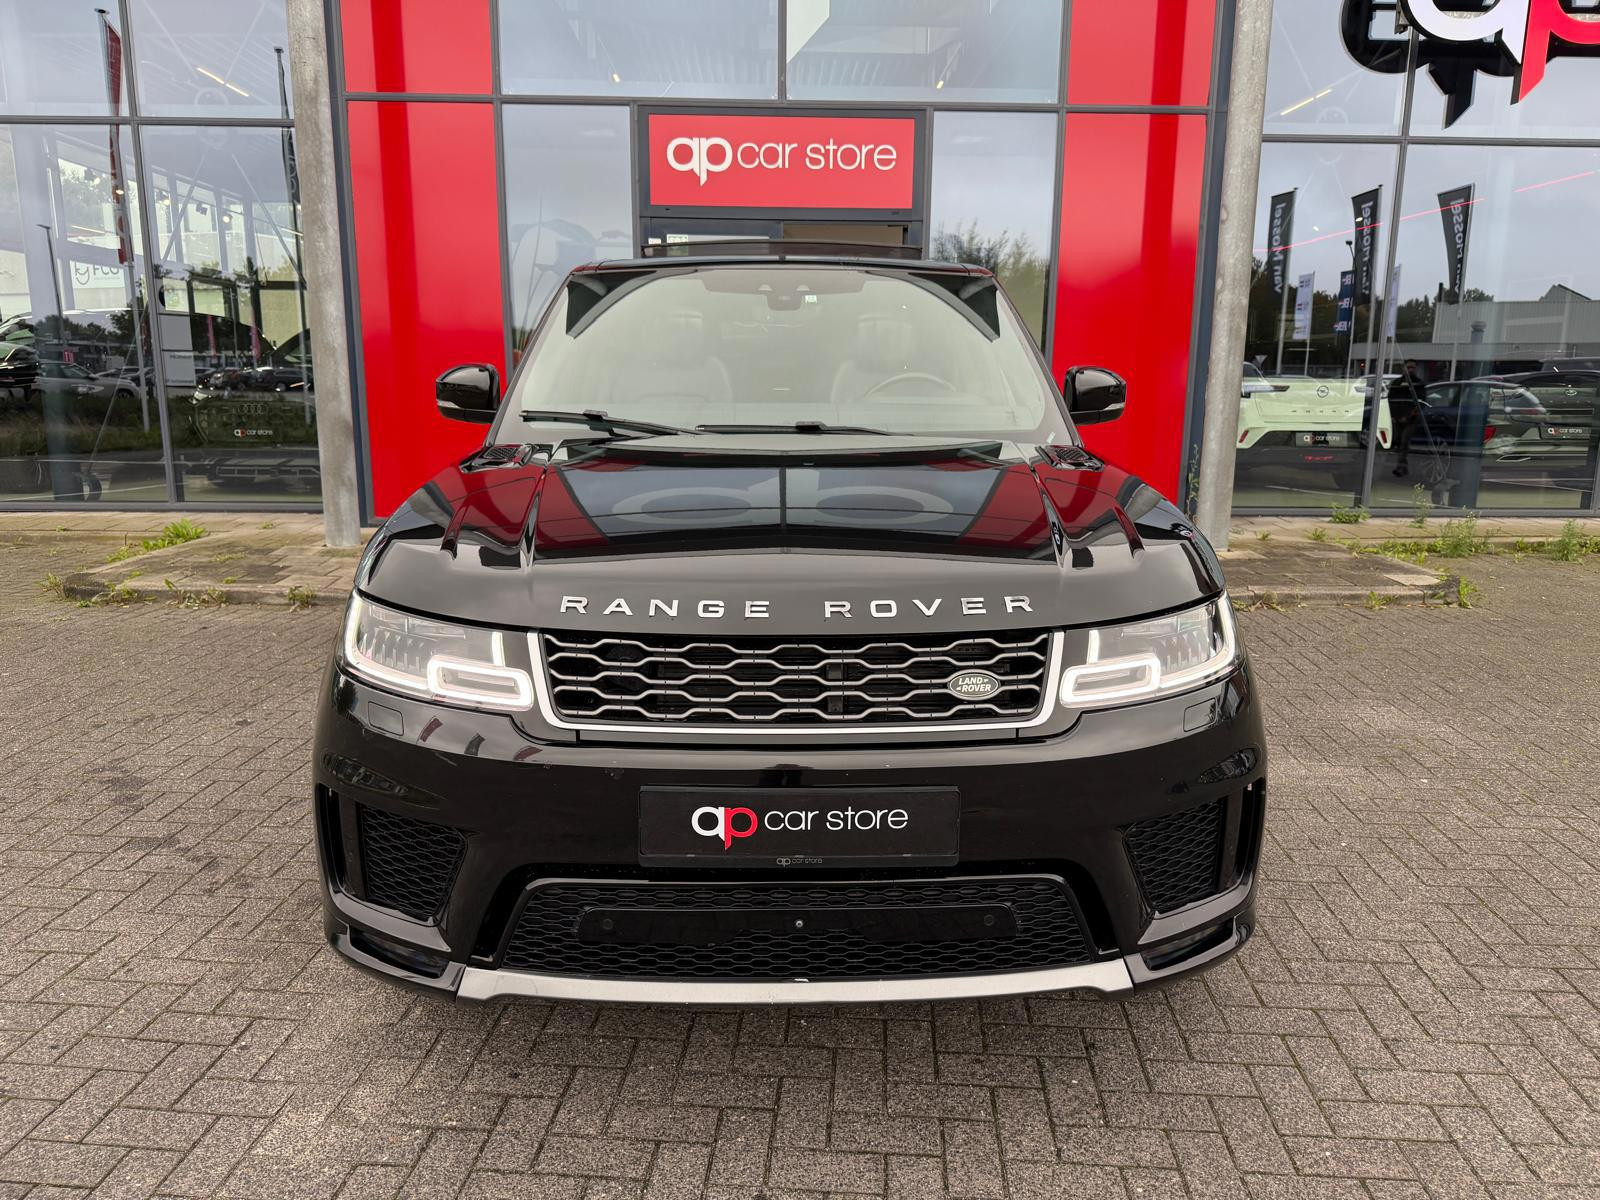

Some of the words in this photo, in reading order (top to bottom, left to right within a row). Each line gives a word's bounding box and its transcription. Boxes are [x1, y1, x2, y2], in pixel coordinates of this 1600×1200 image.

[666, 136, 733, 186] ap
[736, 142, 798, 169] car
[805, 138, 897, 171] store
[560, 595, 770, 619] RANGE
[824, 595, 1033, 619] ROVER
[958, 676, 983, 685] LAND
[961, 683, 992, 693] ROVER
[691, 806, 758, 850] ap
[764, 810, 819, 830] car
[826, 806, 909, 830] store
